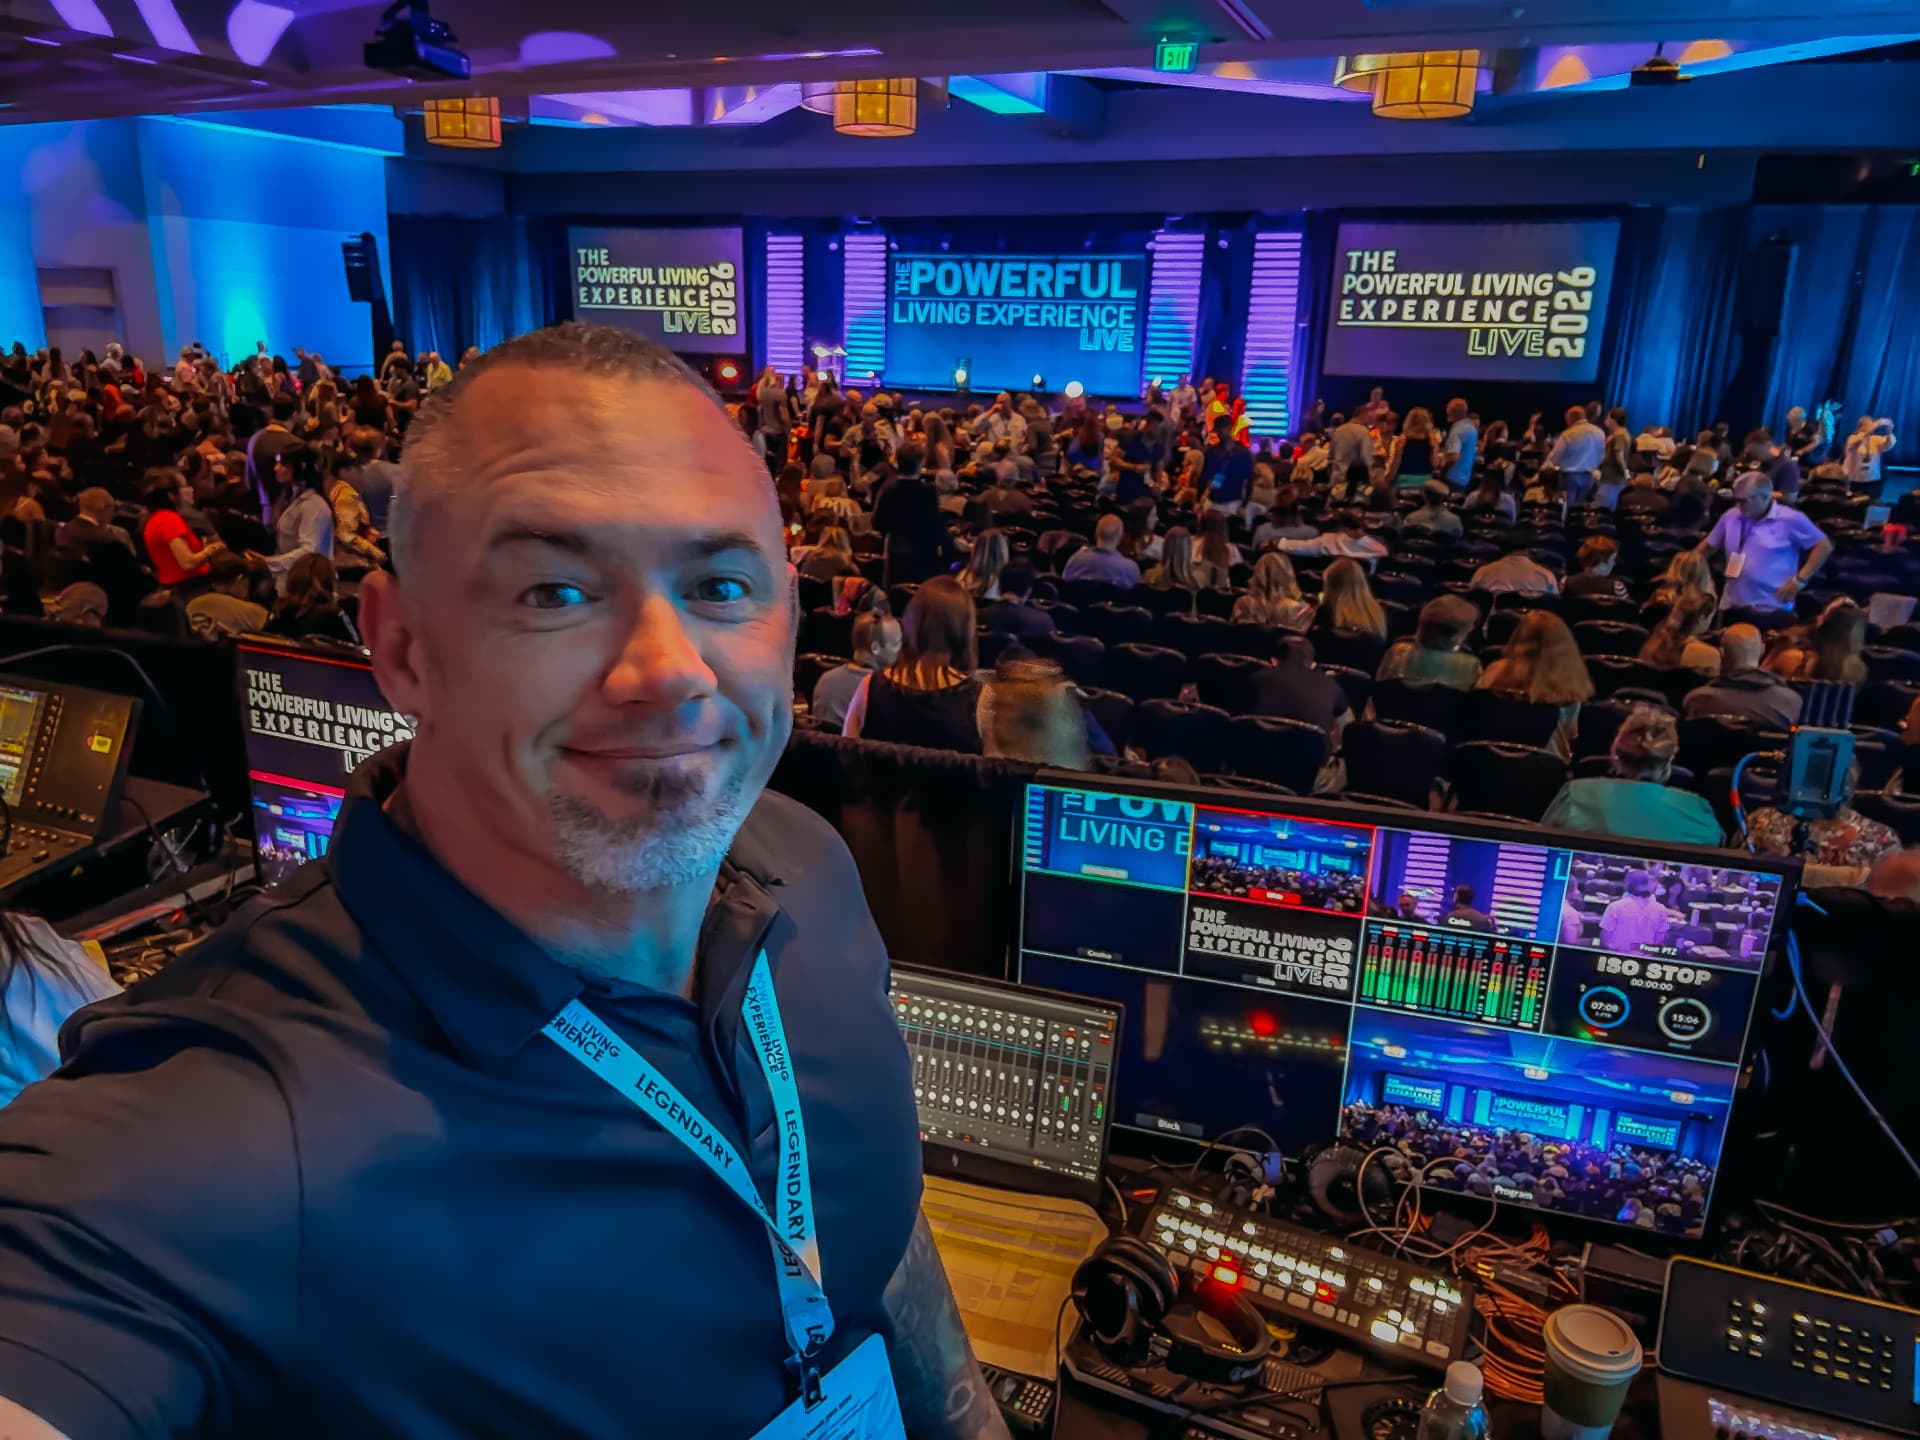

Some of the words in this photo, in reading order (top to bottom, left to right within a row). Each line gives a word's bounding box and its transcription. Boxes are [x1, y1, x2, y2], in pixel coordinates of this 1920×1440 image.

[577, 249, 609, 266] THE
[1346, 250, 1396, 272] THE
[577, 267, 656, 285] POWERFUL
[658, 268, 710, 286] LIVING
[895, 260, 911, 294] THE
[910, 261, 1137, 298] POWERFUL
[1342, 273, 1464, 296] POWERFUL
[1471, 273, 1554, 296] LIVING
[579, 287, 710, 307] EXPERIENCE
[710, 262, 737, 335] 2026
[1339, 299, 1550, 322] EXPERIENCE
[1546, 266, 1596, 358] 2026
[663, 311, 711, 334] LIVE
[893, 302, 971, 325] LIVING
[975, 303, 1136, 329] EXPERIENCE
[1080, 328, 1134, 352] LIVE
[1467, 328, 1545, 357] LIVE
[246, 669, 282, 692] THE
[249, 688, 333, 722] POWERFUL
[336, 704, 394, 732] LIVING
[1060, 817, 1165, 852] LIVING
[1192, 907, 1226, 925] THE
[1189, 934, 1324, 966] EXPERIENCE
[1190, 919, 1271, 945] POWERFUL
[1273, 932, 1327, 952] LIVING
[1274, 963, 1322, 986] LIVE
[1322, 938, 1353, 991] 2026
[1597, 956, 1639, 976] ISO
[1646, 963, 1712, 985] STOP
[551, 1015, 605, 1062] RIENCE
[582, 1020, 621, 1058] LIVING
[747, 986, 779, 1074] EXPERIENCE
[771, 1039, 789, 1082] LIVING
[635, 1073, 733, 1168] LEGENDARY
[784, 1109, 806, 1240] LEGENDARY
[1494, 1184, 1534, 1200] Program
